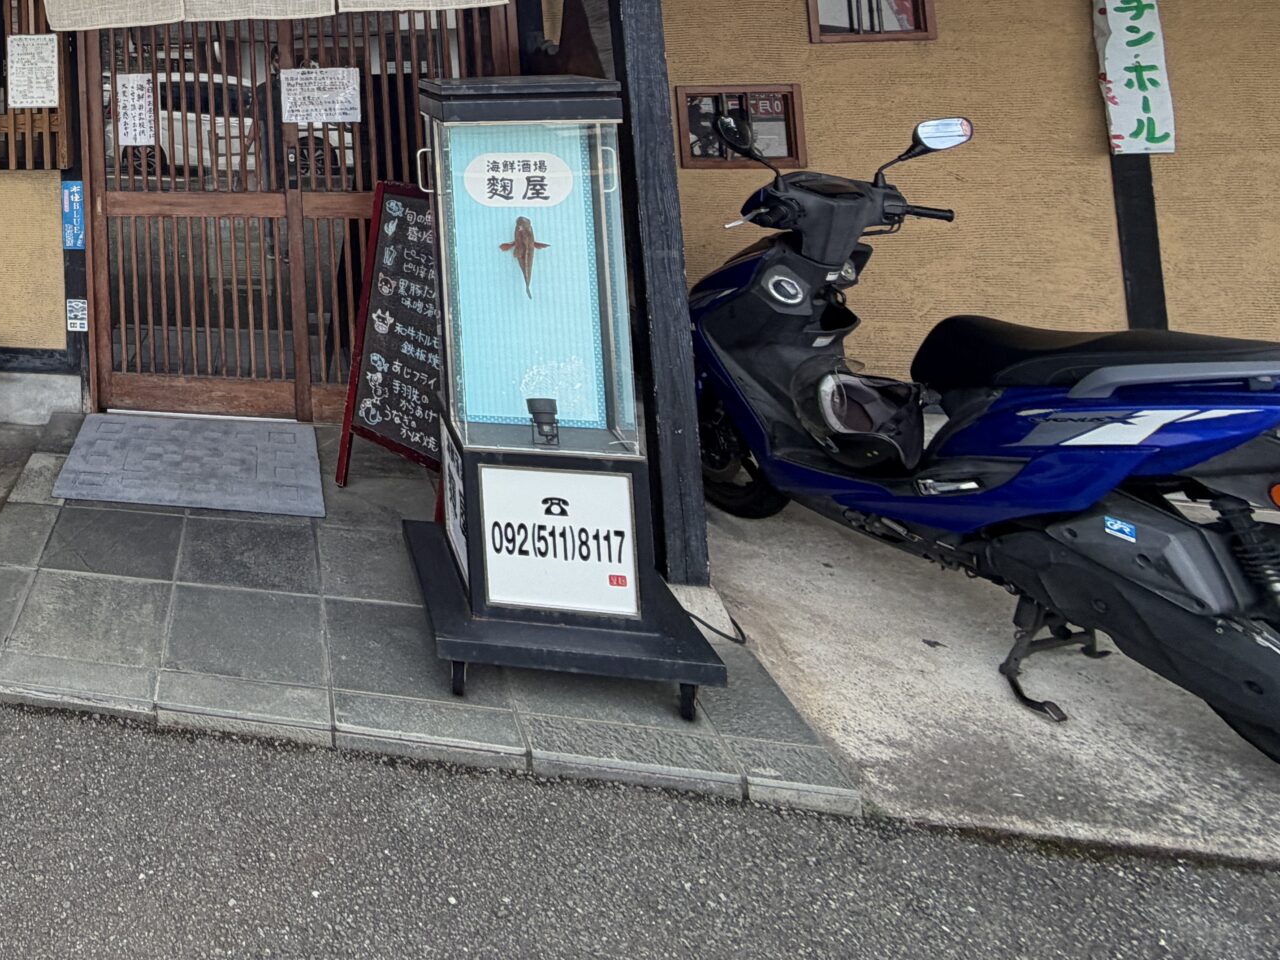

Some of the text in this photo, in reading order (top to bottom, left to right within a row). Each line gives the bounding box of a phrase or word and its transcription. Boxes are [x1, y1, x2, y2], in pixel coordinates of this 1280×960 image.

[486, 159, 548, 173] 海鮮酒場
[392, 359, 437, 390] あじフライ
[491, 521, 626, 564] 092(511)8117
